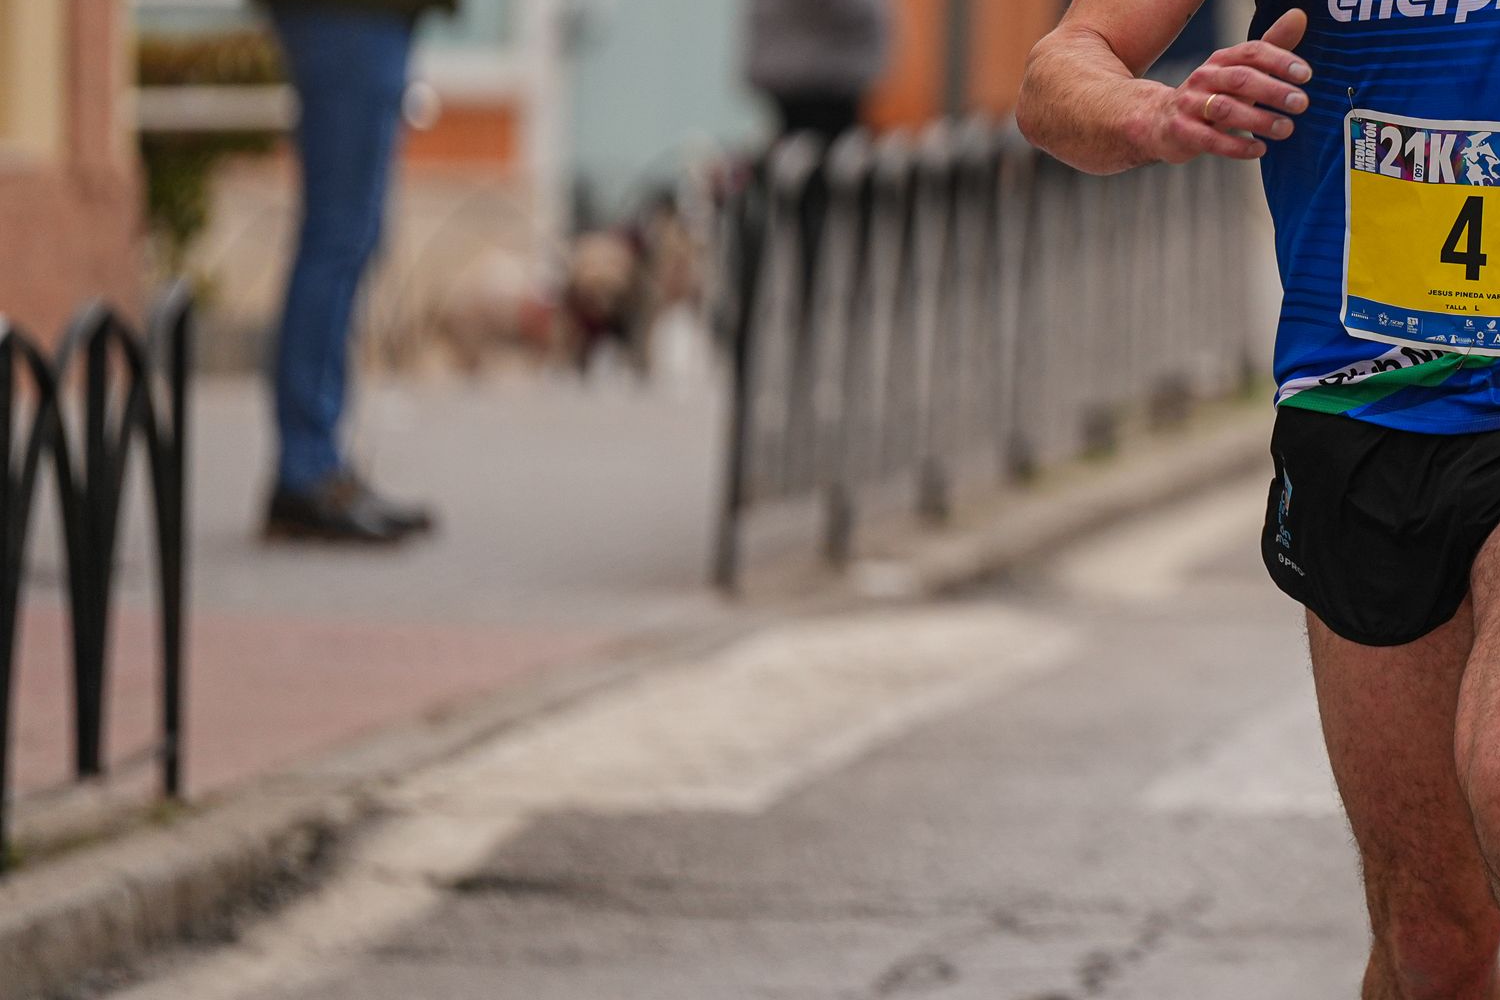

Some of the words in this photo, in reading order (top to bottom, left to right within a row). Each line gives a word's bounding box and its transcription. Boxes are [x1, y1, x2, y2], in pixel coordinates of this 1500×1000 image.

[1355, 139, 1365, 170] MEDIA
[1364, 122, 1376, 173] MARATÓN
[1380, 126, 1457, 183] 21K
[1439, 195, 1487, 281] 4
[1428, 289, 1453, 298] JESUS
[1455, 291, 1485, 300] PINEDA
[1445, 303, 1468, 311] TALLA
[1474, 304, 1480, 312] L
